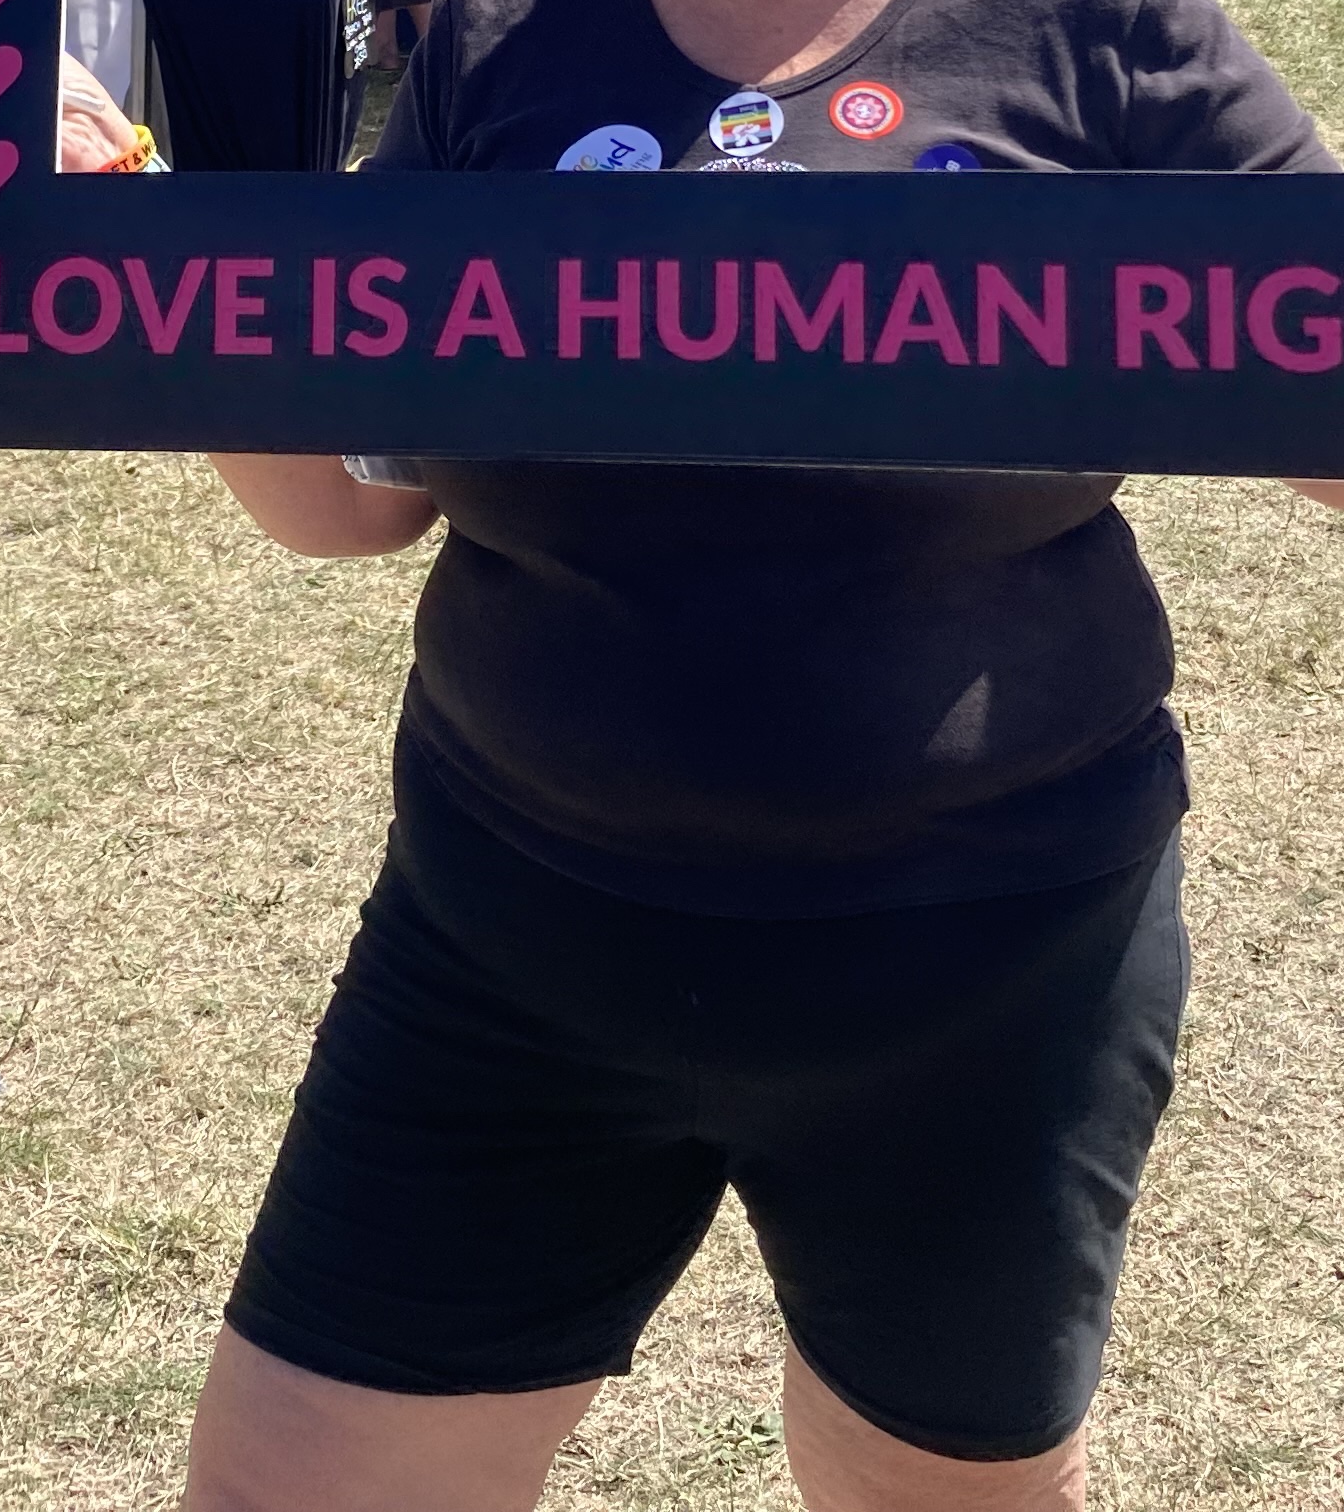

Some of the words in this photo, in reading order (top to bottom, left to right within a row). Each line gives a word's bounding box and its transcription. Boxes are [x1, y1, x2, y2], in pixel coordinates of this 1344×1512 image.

[312, 257, 408, 358] IS
[434, 258, 526, 359] A
[557, 260, 1068, 367] HUMAN
